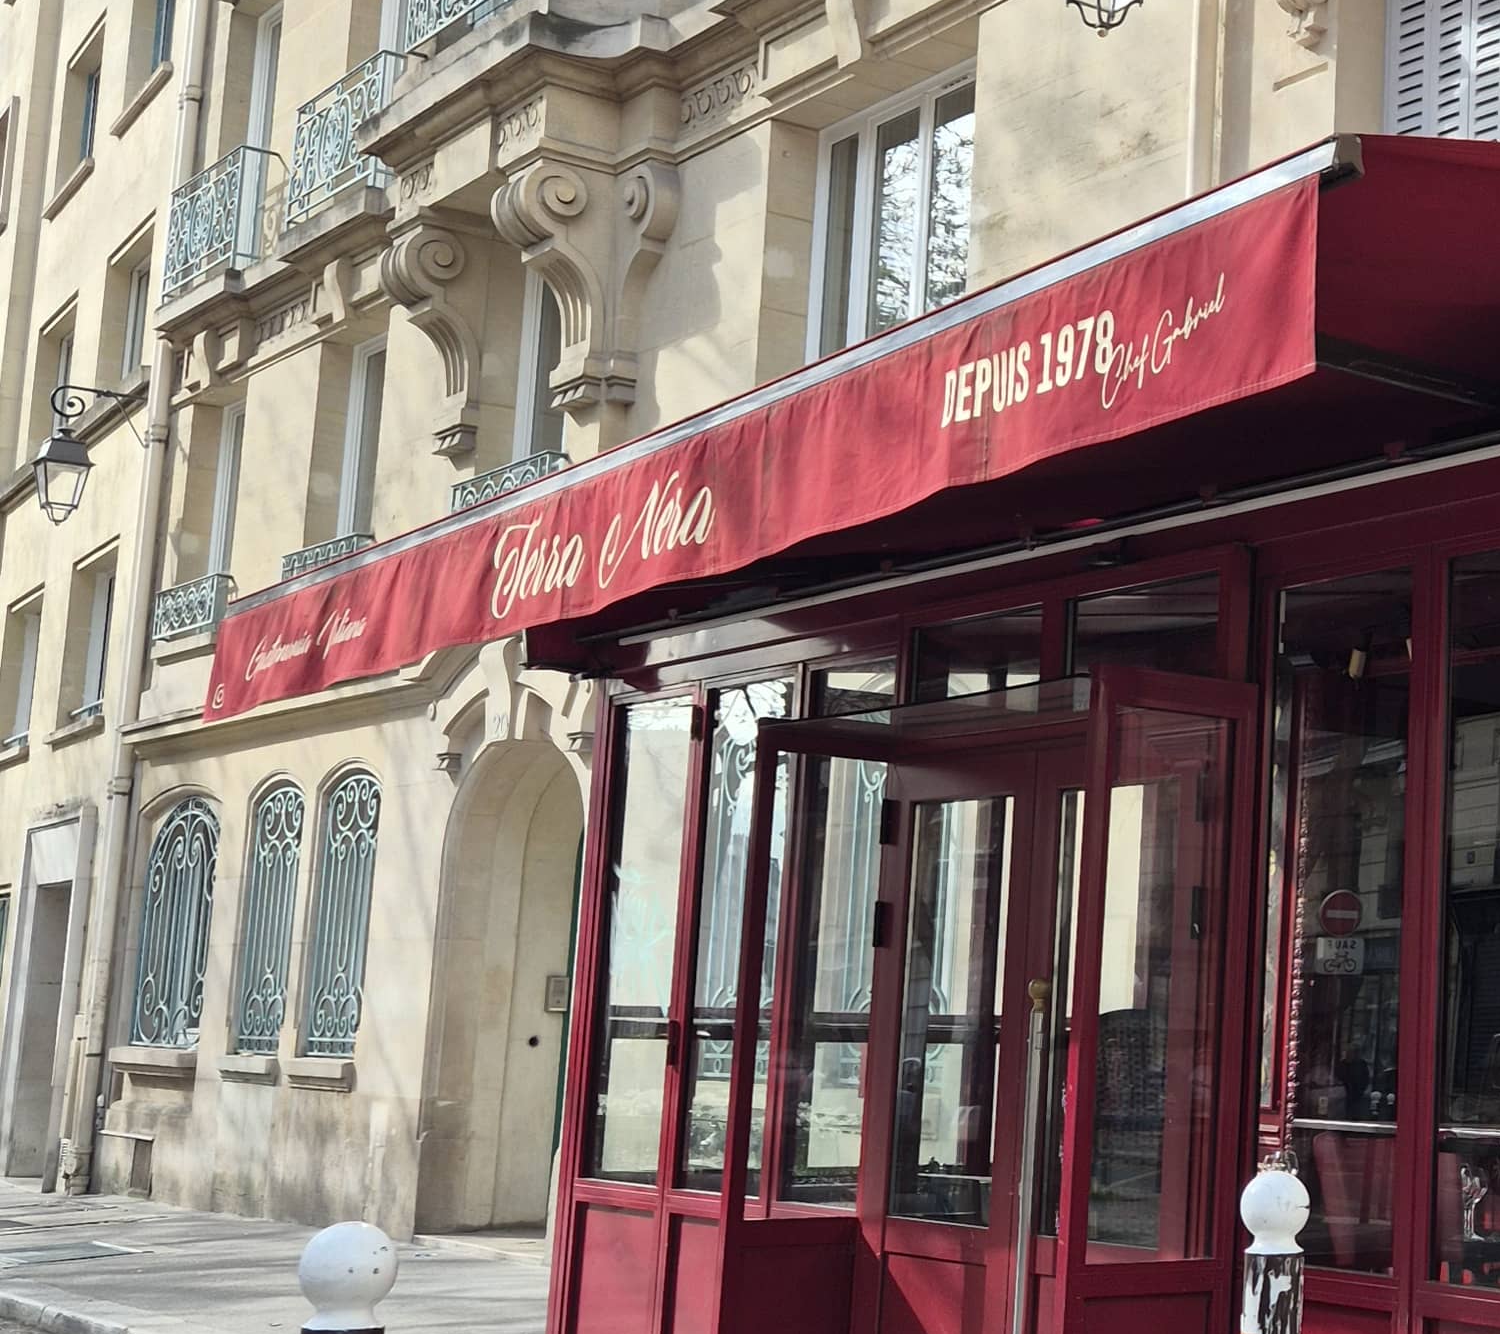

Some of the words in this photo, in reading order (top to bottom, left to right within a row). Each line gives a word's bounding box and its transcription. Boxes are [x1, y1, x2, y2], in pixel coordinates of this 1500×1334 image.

[940, 340, 1031, 429] DEPUIS
[1036, 309, 1115, 395] 1978
[1101, 333, 1150, 409] Chef
[1151, 271, 1226, 375] Gabriel
[491, 511, 586, 620] Terra
[599, 470, 717, 590] Nera
